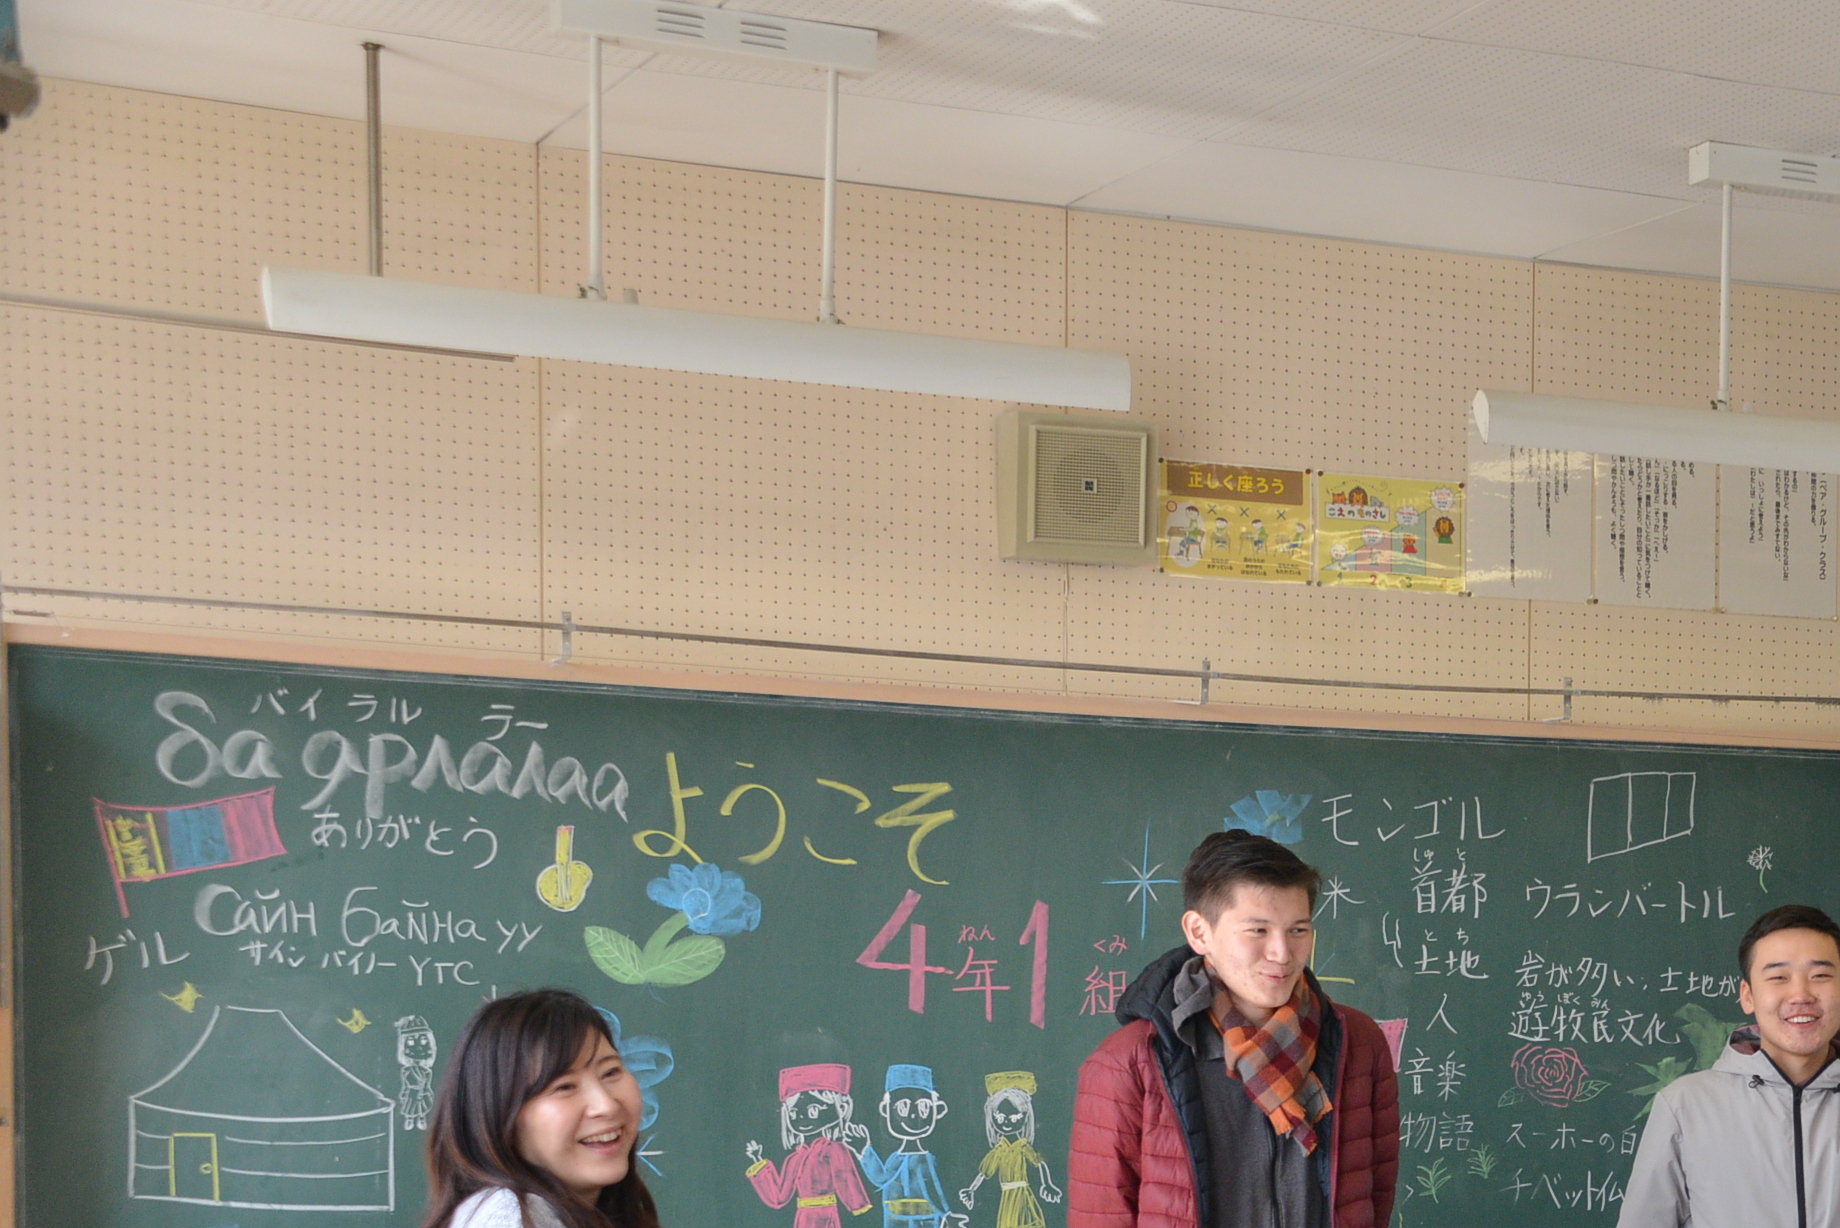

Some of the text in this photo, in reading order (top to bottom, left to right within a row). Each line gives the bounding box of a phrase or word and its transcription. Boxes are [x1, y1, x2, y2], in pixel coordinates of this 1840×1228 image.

[1188, 470, 1285, 494] 正しく座ろう
[1328, 507, 1386, 519] こえのものさし
[1370, 575, 1377, 585] 2
[310, 806, 499, 869] ありがとう
[632, 752, 958, 885] ようこそ
[1322, 794, 1505, 847] モンゴル
[1411, 861, 1736, 923] 首都 ウランバートル
[84, 929, 191, 985] ゲル
[958, 924, 996, 944] ねん
[1093, 934, 1128, 956] くみ
[1426, 993, 1681, 1047] 人 遊牧民文化
[1404, 1047, 1467, 1101] 音楽
[1399, 1111, 1474, 1153] 物語
